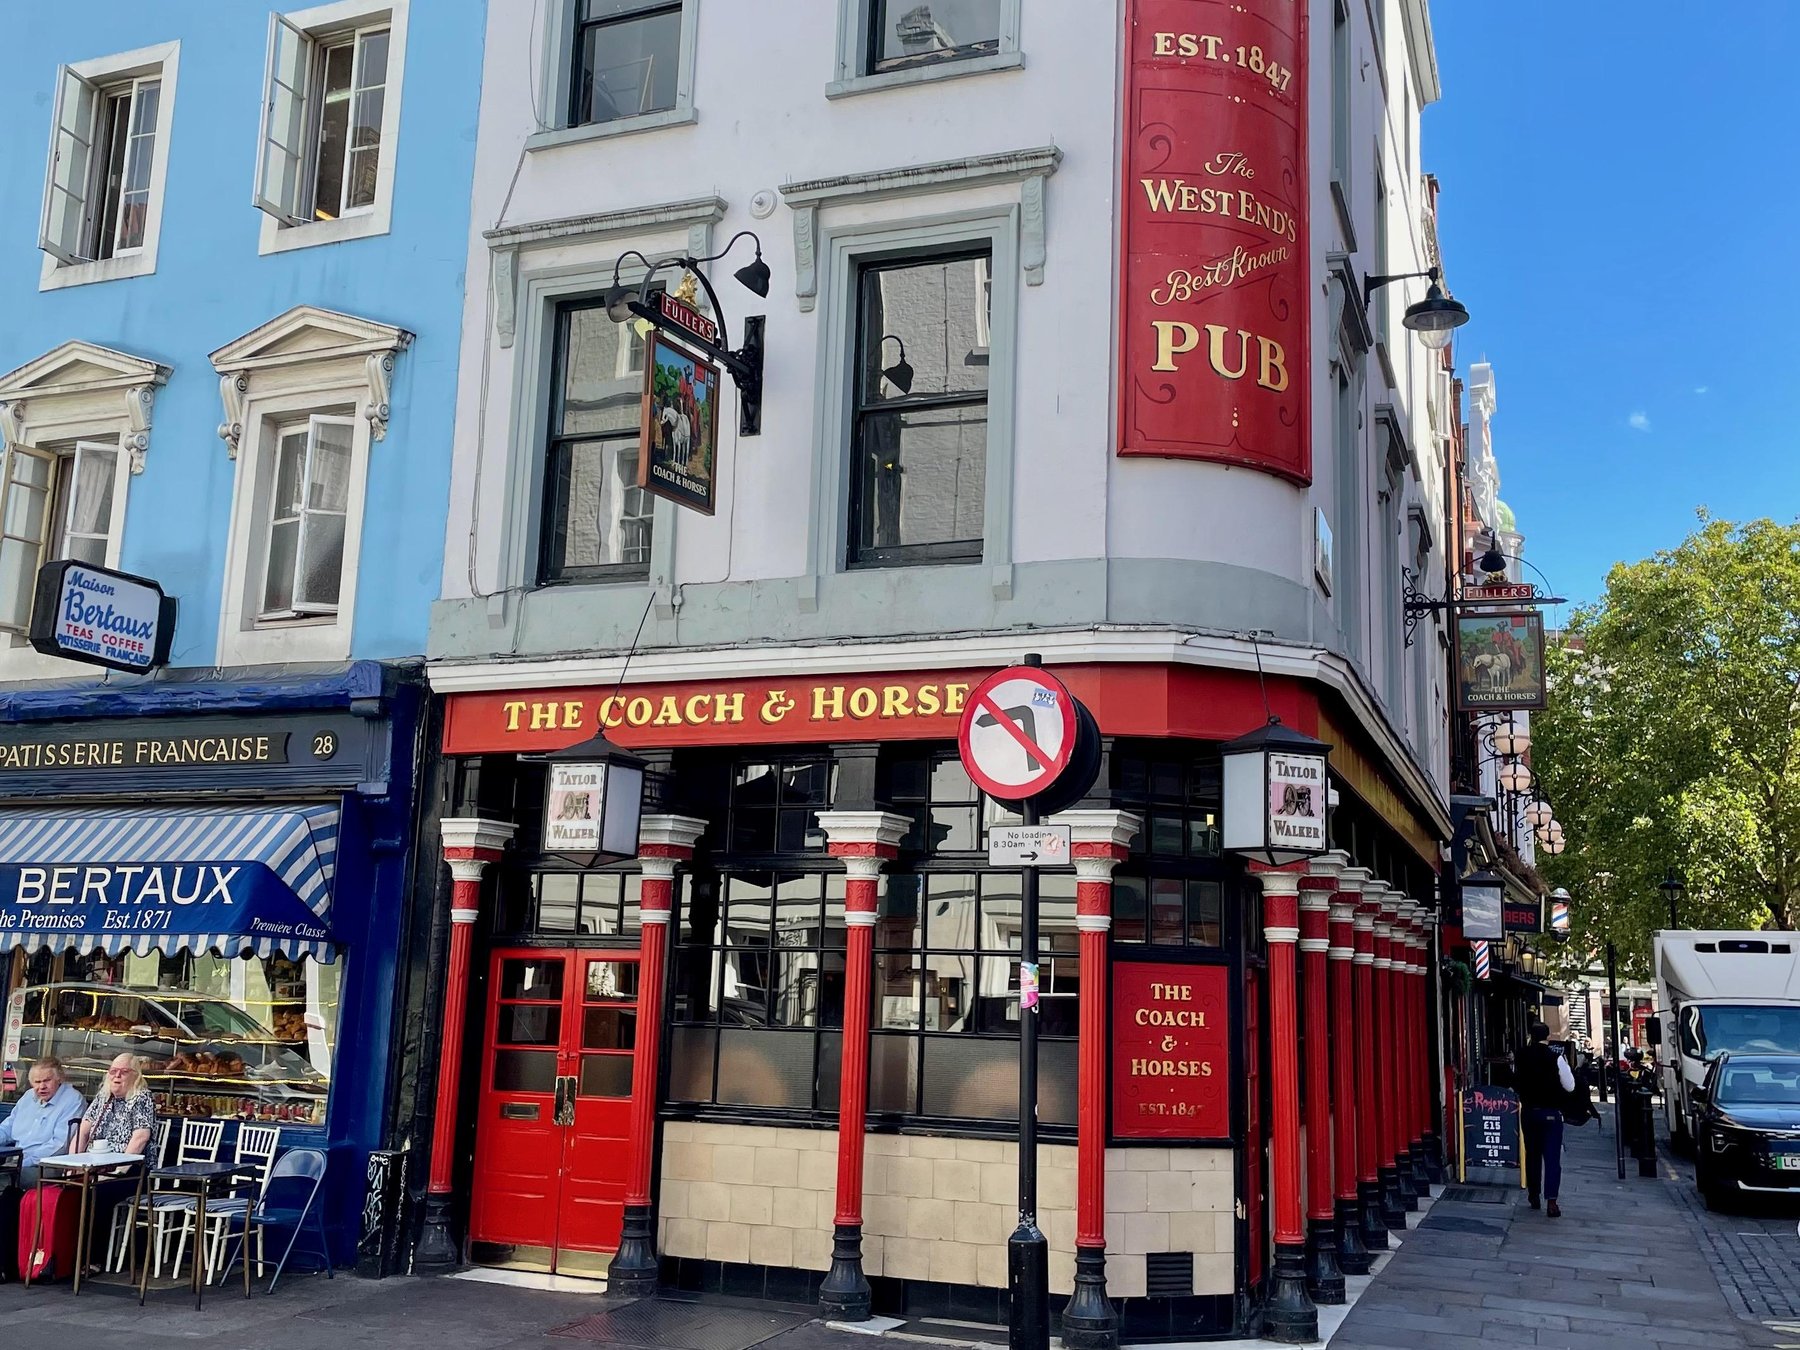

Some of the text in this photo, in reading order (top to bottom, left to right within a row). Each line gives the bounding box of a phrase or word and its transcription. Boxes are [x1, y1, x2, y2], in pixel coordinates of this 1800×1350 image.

[1204, 151, 1256, 180] The
[1140, 179, 1234, 216] WEST
[1150, 245, 1291, 306] Best Known
[664, 295, 713, 339] FULLER'S
[1150, 320, 1289, 392] PUB
[671, 461, 688, 477] THE
[653, 464, 707, 497] COACH & HORSES
[67, 571, 115, 596] Maison
[1467, 586, 1528, 598] FULLER'S
[64, 588, 154, 640] Bertaux
[56, 633, 102, 654] PATISSERIE
[65, 623, 144, 653] TEAS COFFEE
[1467, 692, 1537, 701] COACH & HORSES
[1490, 685, 1510, 693] THE
[504, 682, 970, 732] THE COACH & HORSE
[0, 736, 270, 769] PATISSERIE FRANCAISE
[312, 737, 334, 756] 28
[558, 772, 597, 785] TAYLOR
[1275, 760, 1318, 780] TAYLOR
[552, 824, 595, 840] WALKER
[1273, 819, 1320, 839] WALKER
[993, 840, 1026, 849] 830am
[15, 865, 241, 905] BERTAUX
[0, 909, 16, 929] he
[18, 909, 87, 930] Premises
[1504, 910, 1535, 925] BERS
[250, 917, 327, 939] Première Classe
[1150, 983, 1192, 1001] THE
[1135, 1008, 1206, 1027] COACH
[1161, 1035, 1178, 1052] &
[1131, 1058, 1212, 1077] HORSES
[1483, 1121, 1501, 1130] £15
